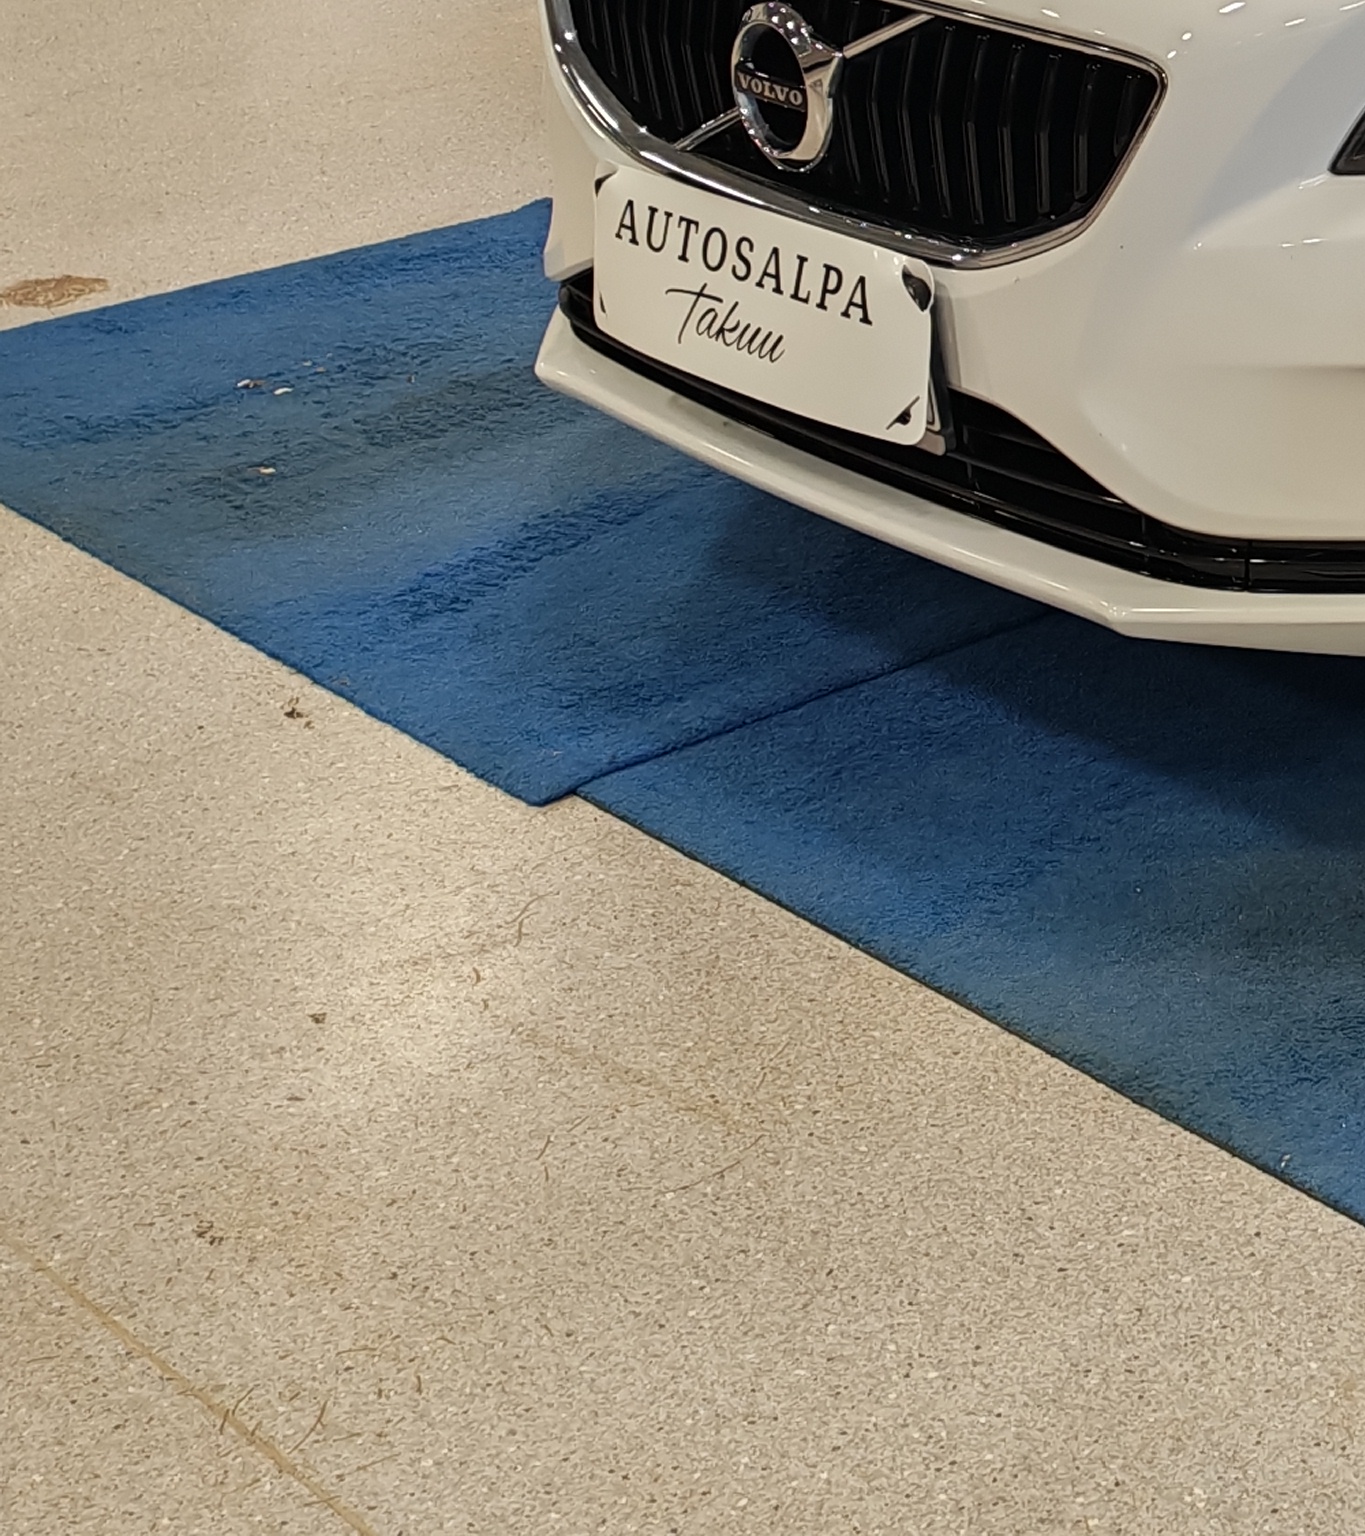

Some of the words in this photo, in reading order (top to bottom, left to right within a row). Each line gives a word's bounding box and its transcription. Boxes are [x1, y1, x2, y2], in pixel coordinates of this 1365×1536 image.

[736, 71, 804, 106] VOLVO
[615, 199, 874, 326] AUTOSALPA
[665, 282, 786, 364] Takuu
